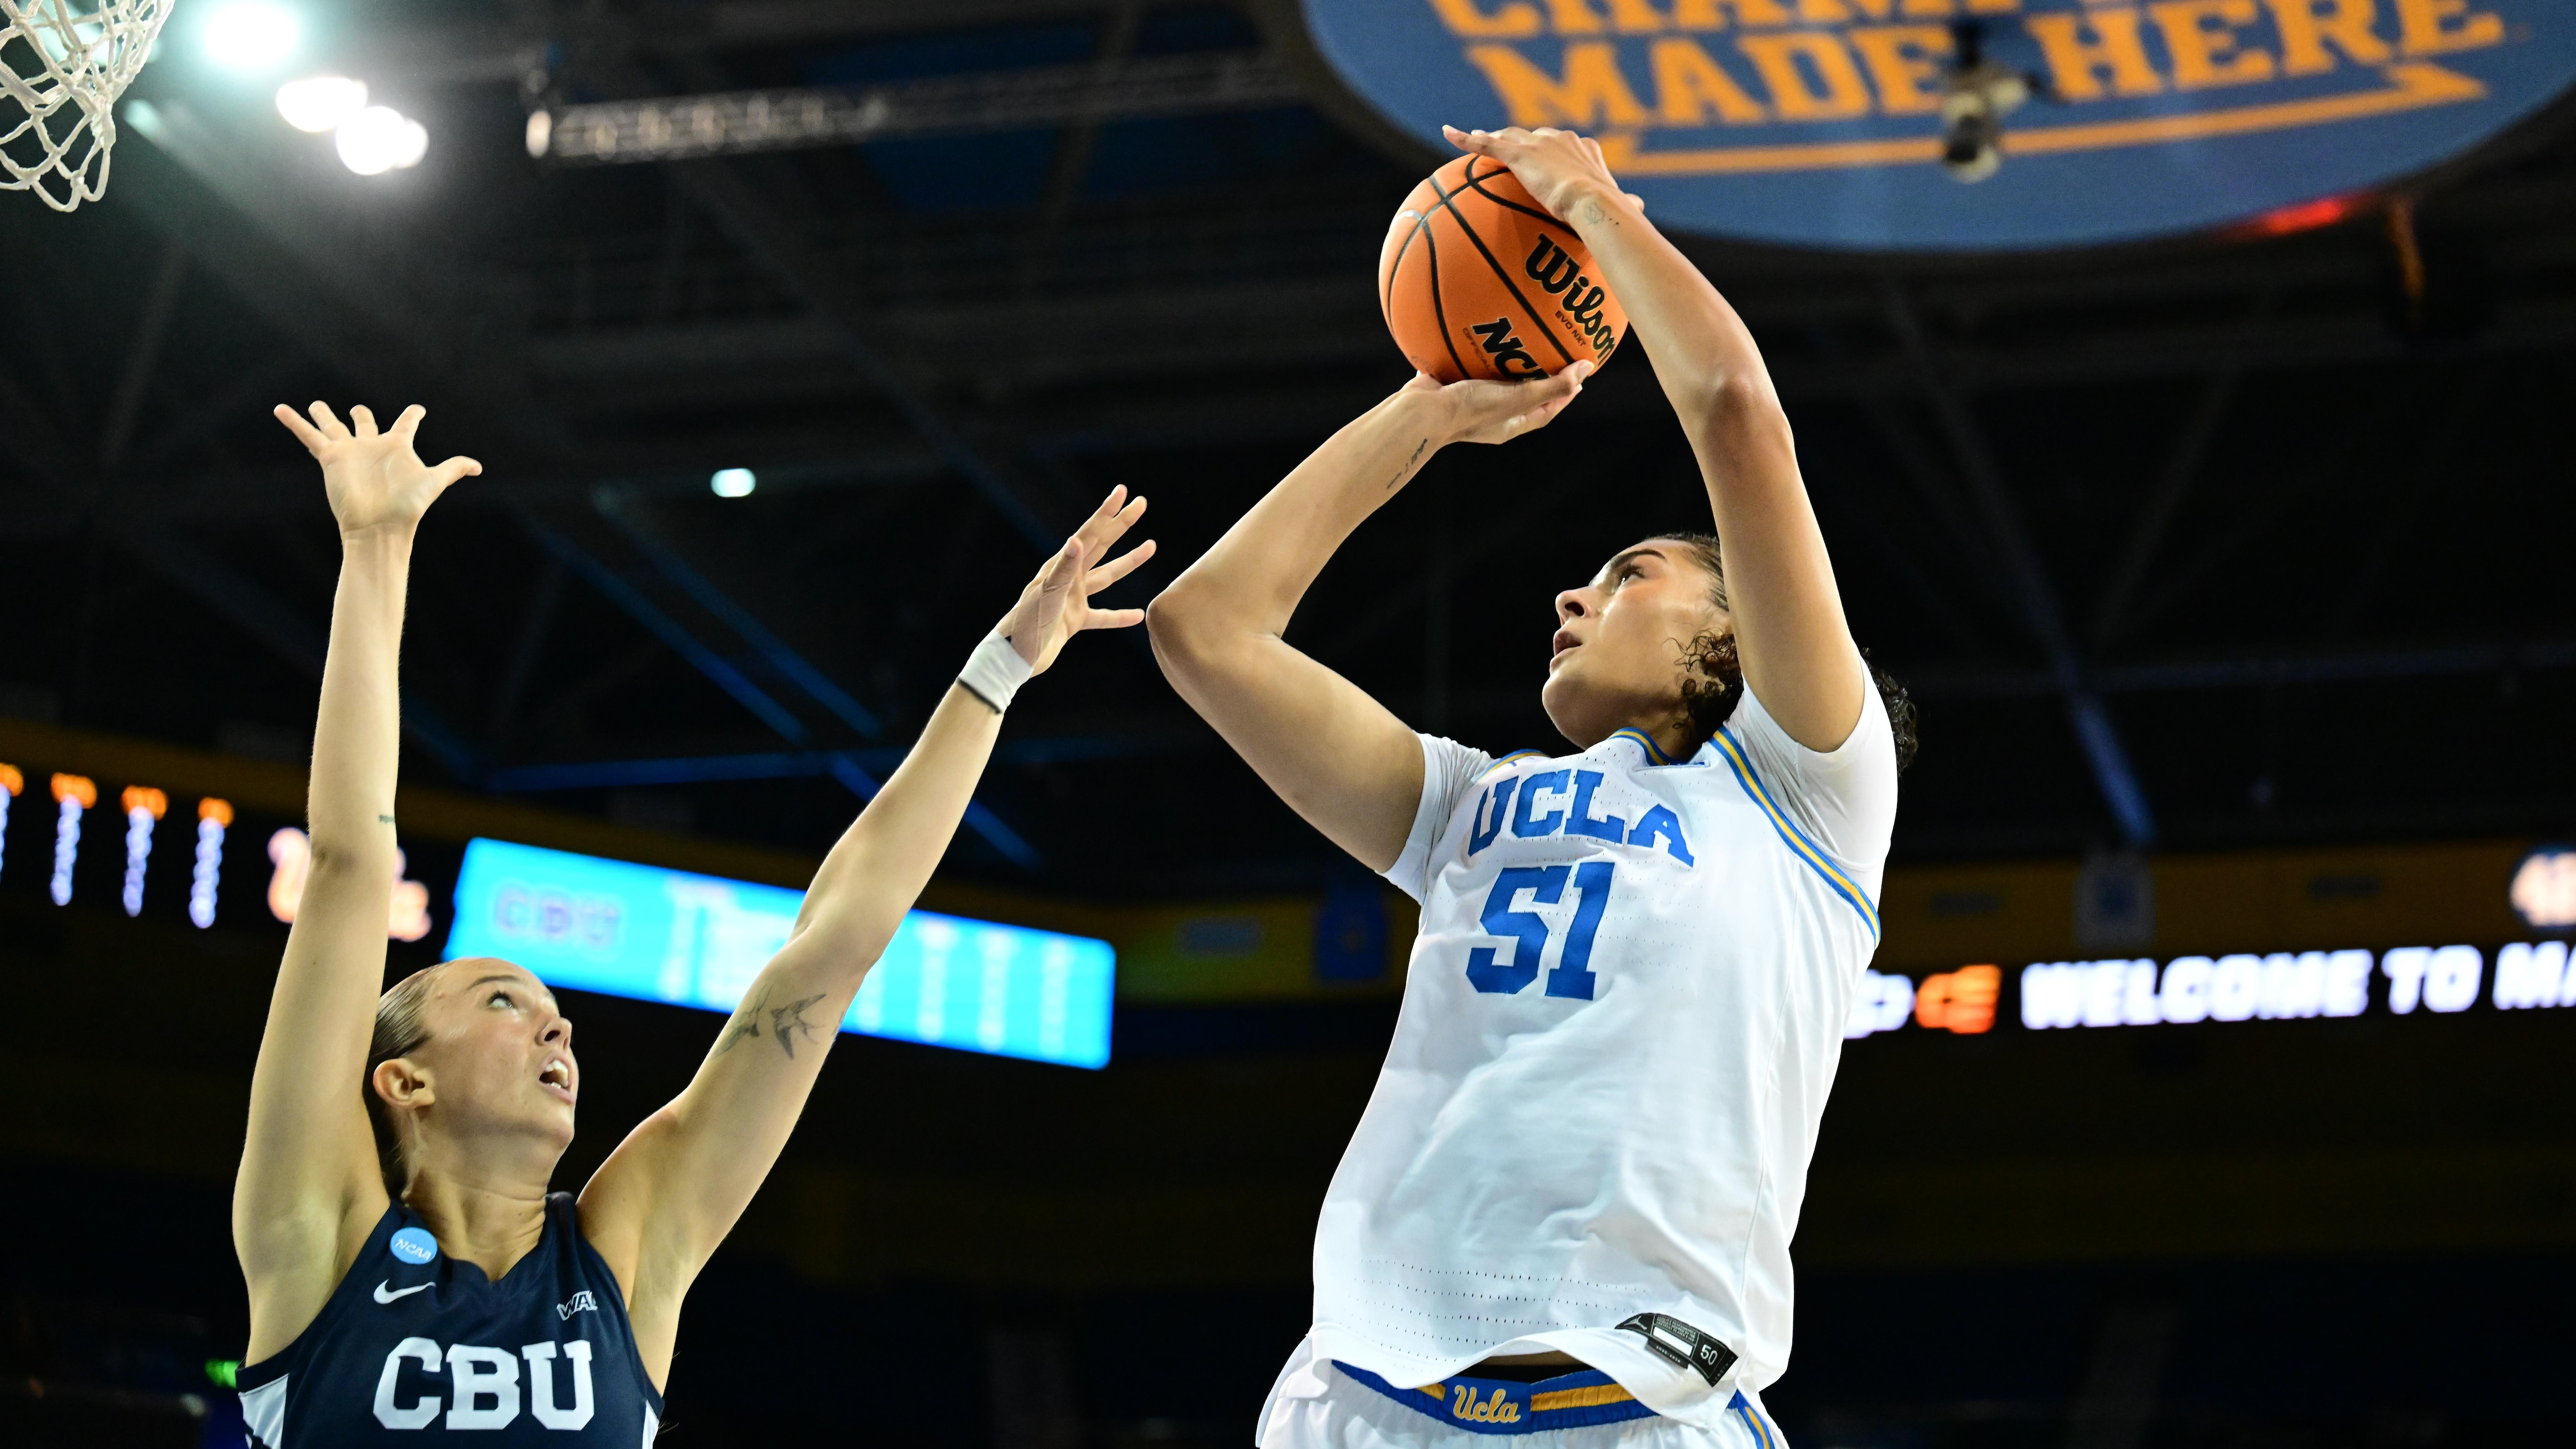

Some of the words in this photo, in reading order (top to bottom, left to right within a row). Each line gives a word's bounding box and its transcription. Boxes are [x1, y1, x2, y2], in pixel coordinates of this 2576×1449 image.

[1466, 25, 1954, 129] MADE
[2025, 0, 2506, 103] HERE
[1524, 232, 1615, 366] Wilson
[1572, 330, 1586, 347] NXT
[1467, 769, 1694, 868] UCLA
[1465, 861, 1616, 1001] 51
[2021, 949, 2374, 1030] WELCOME
[2380, 944, 2484, 1014] TO
[395, 1237, 432, 1261] NCAA
[556, 1290, 598, 1321] WA
[372, 1336, 595, 1431] CBU
[1700, 1344, 1718, 1366] 50
[1452, 1384, 1521, 1424] Ucla
